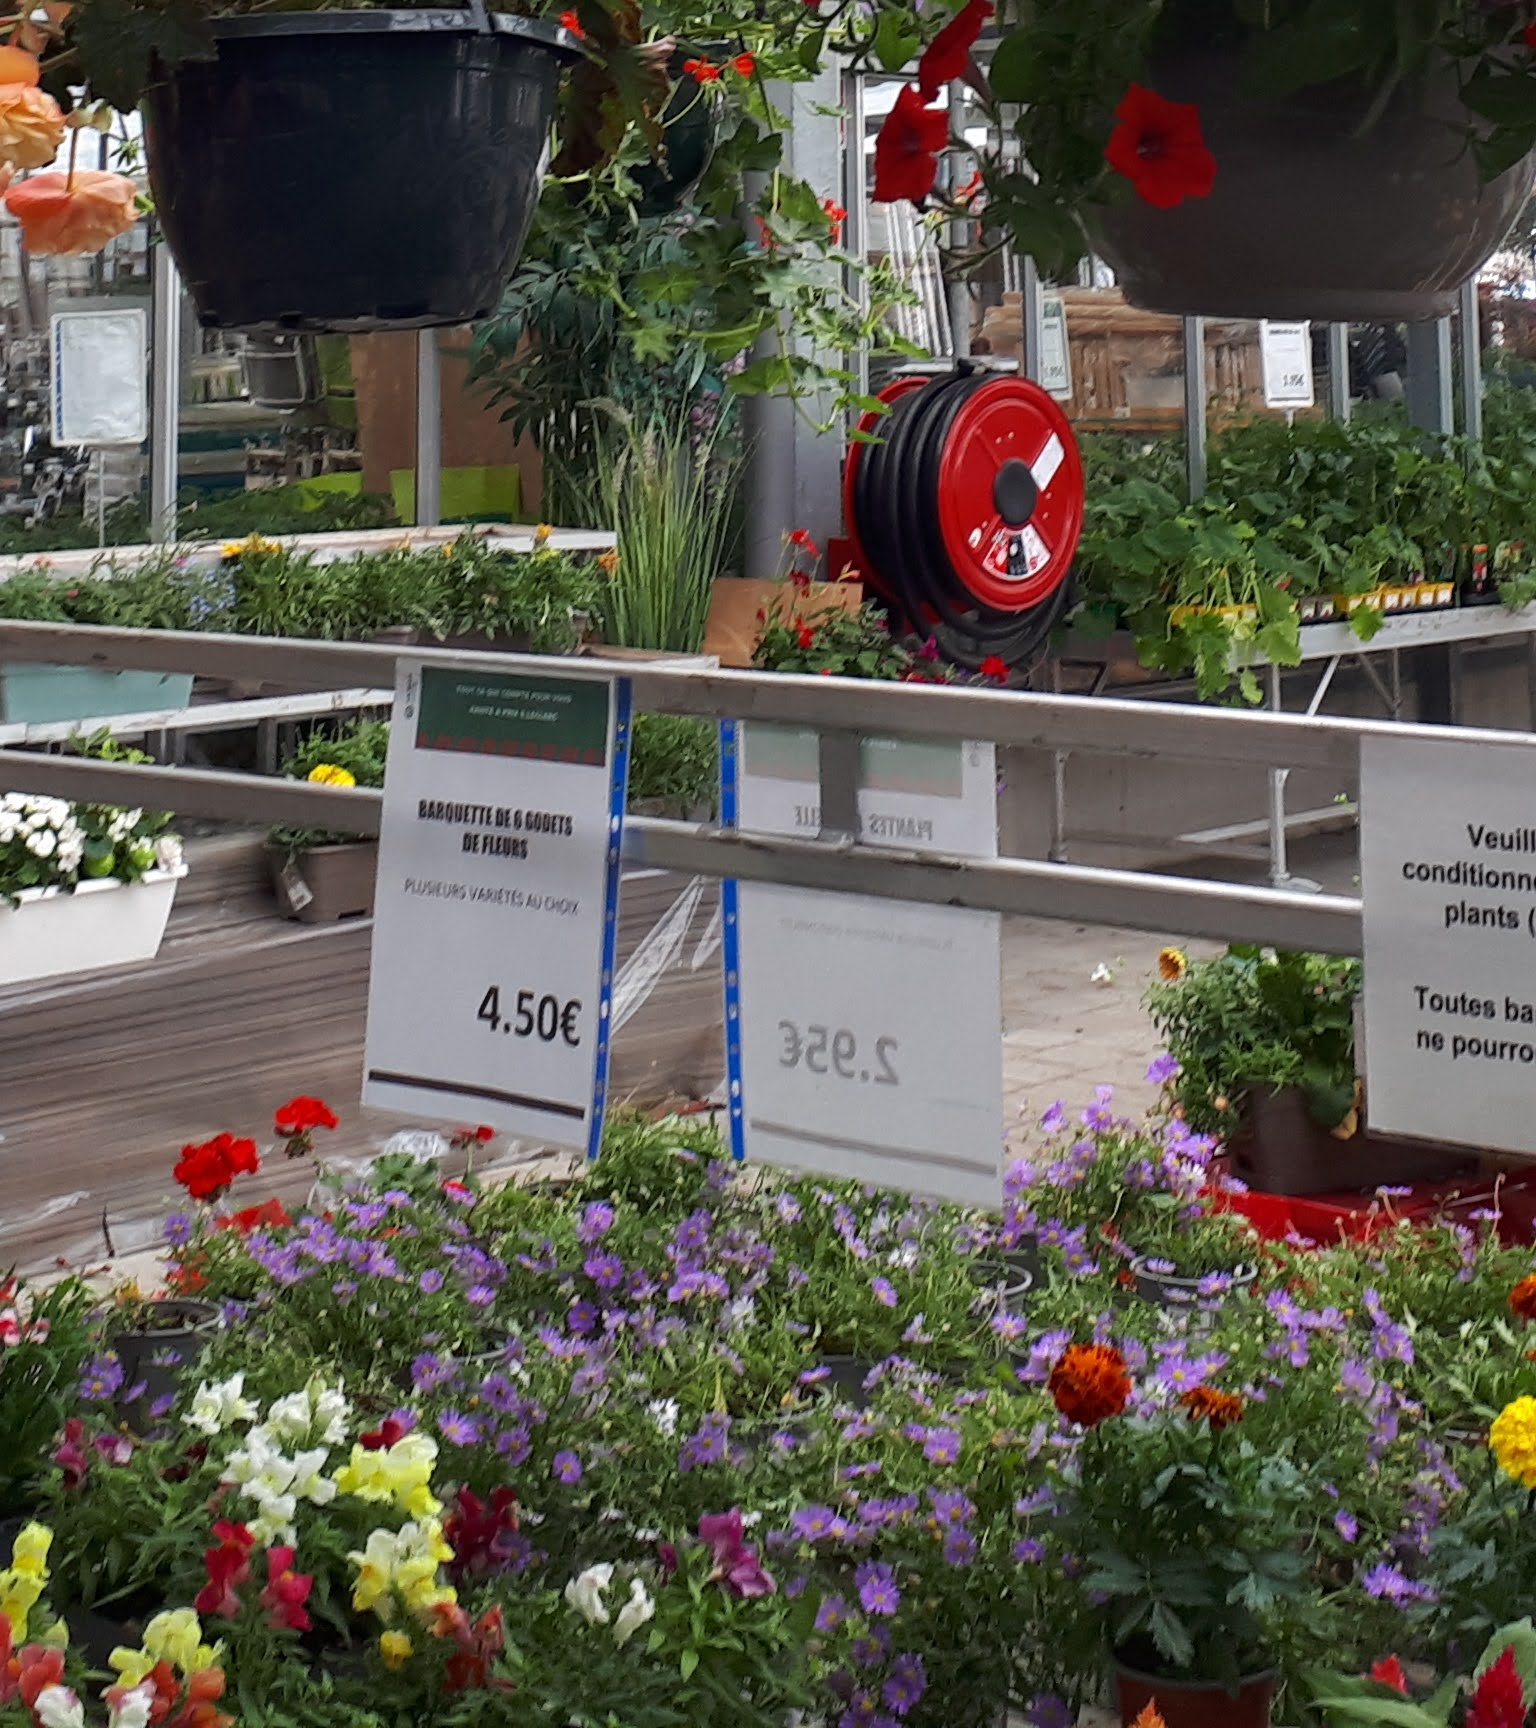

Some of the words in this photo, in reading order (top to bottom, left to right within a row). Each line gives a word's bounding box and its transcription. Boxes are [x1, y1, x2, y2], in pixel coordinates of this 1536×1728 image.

[418, 799, 493, 825] BARQUETTE
[495, 807, 512, 828] DE
[514, 809, 523, 830] 6
[525, 810, 573, 836] GODETS
[462, 832, 479, 853] DE
[482, 834, 528, 859] FLEURS
[404, 878, 466, 900] PLUSIEURS
[525, 893, 543, 910] AU
[544, 895, 580, 916] CHOIX
[1444, 901, 1519, 931] plants
[476, 984, 582, 1047] 4.50€
[1414, 985, 1496, 1020] Toutes
[1417, 1029, 1444, 1053] ne
